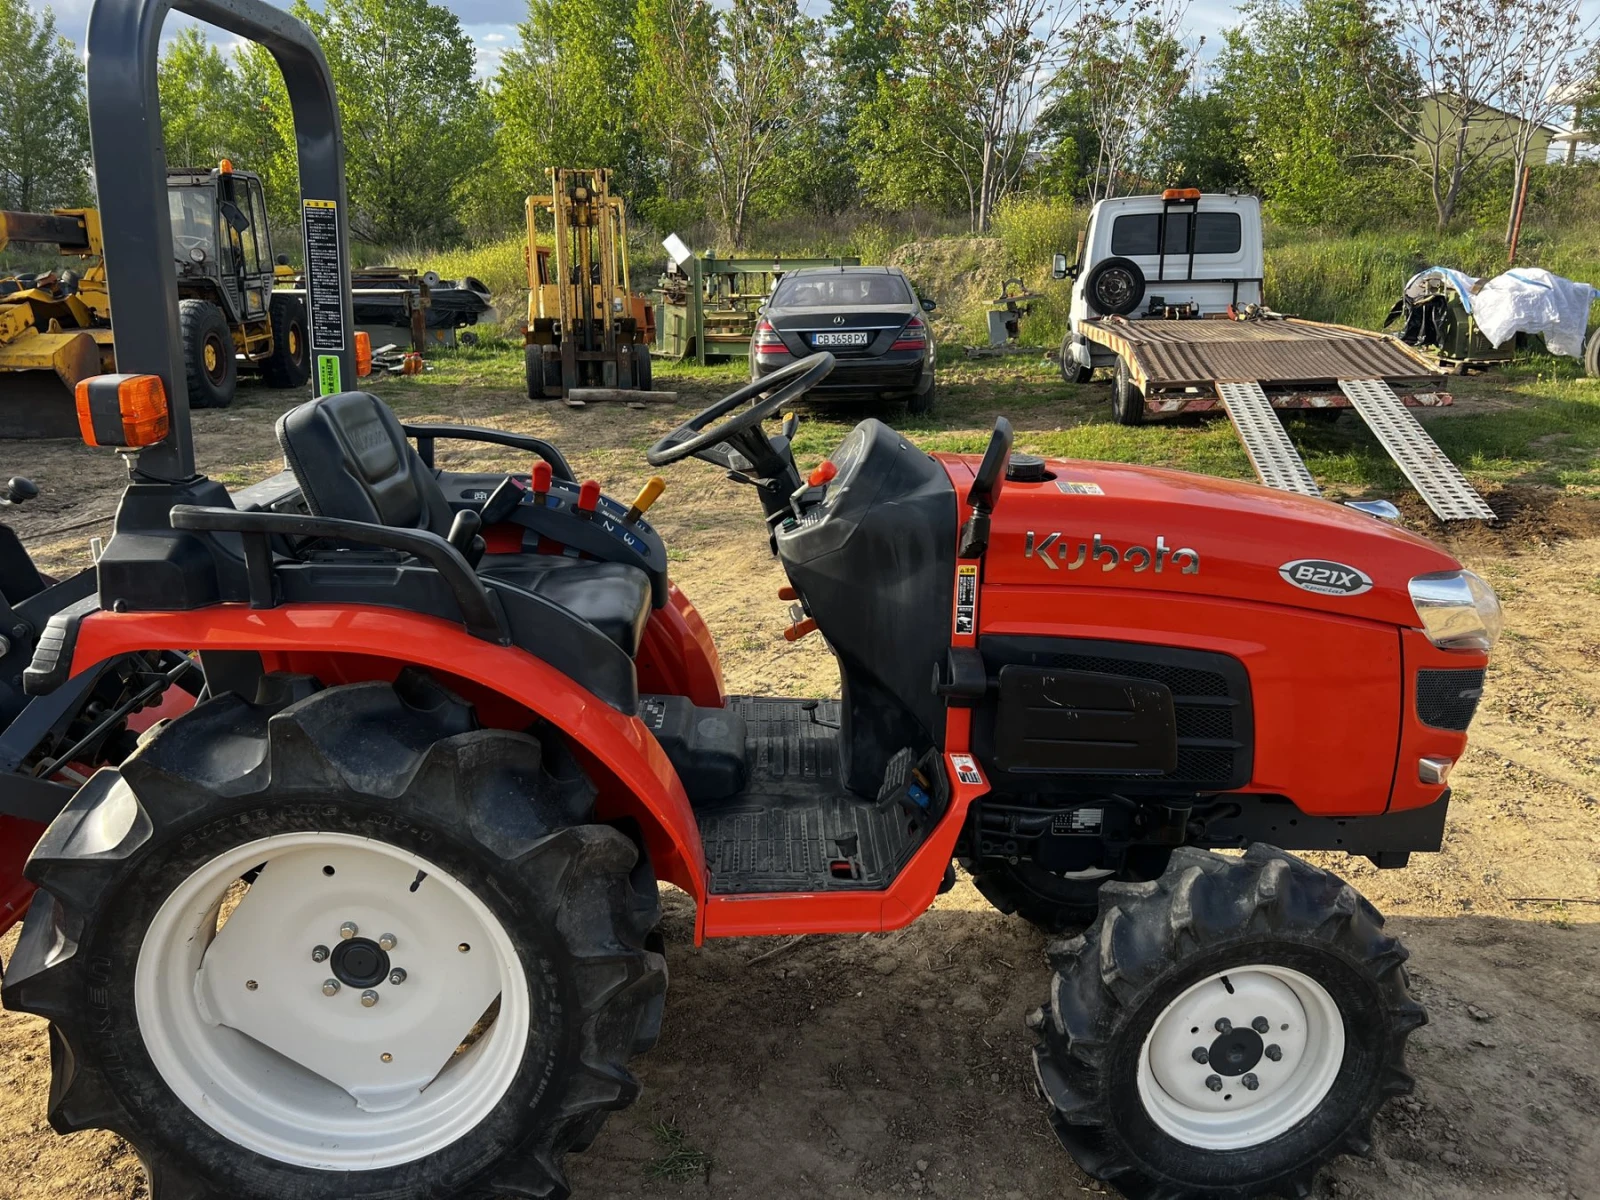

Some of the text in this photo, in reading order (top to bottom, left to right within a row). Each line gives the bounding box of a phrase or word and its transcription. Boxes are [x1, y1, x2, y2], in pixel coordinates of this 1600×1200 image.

[817, 334, 866, 344] CB 3658 PX
[603, 520, 635, 546] 2 3
[1025, 531, 1199, 574] Kubota
[1295, 565, 1356, 587] B21X
